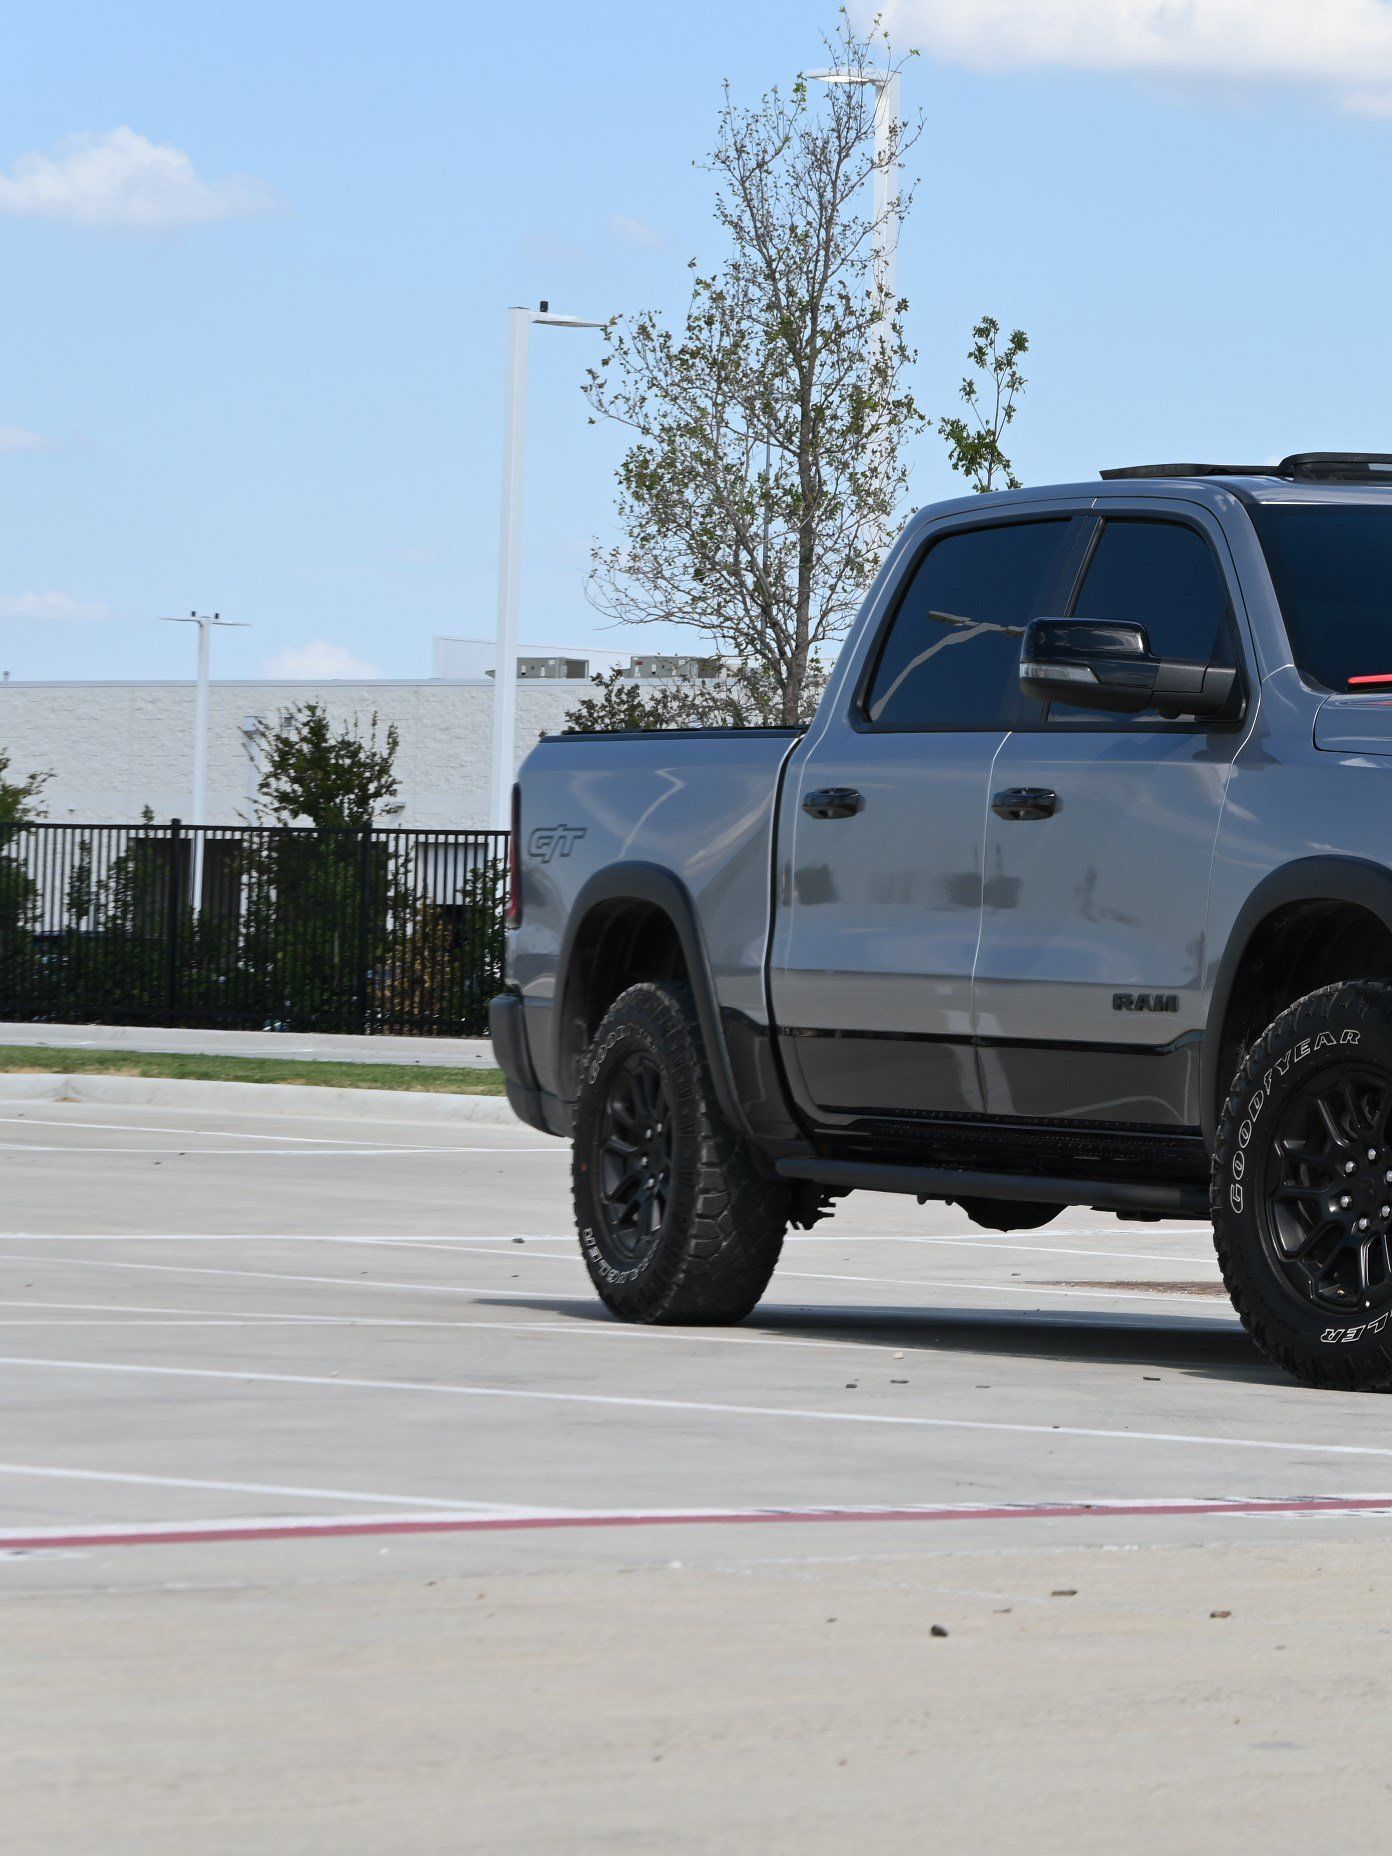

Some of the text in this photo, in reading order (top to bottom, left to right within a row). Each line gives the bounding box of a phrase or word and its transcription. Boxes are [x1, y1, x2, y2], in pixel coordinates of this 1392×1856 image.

[1112, 992, 1180, 1012] RAM
[1230, 1029, 1361, 1214] GOODYEAR
[583, 1227, 662, 1284] NGLER
